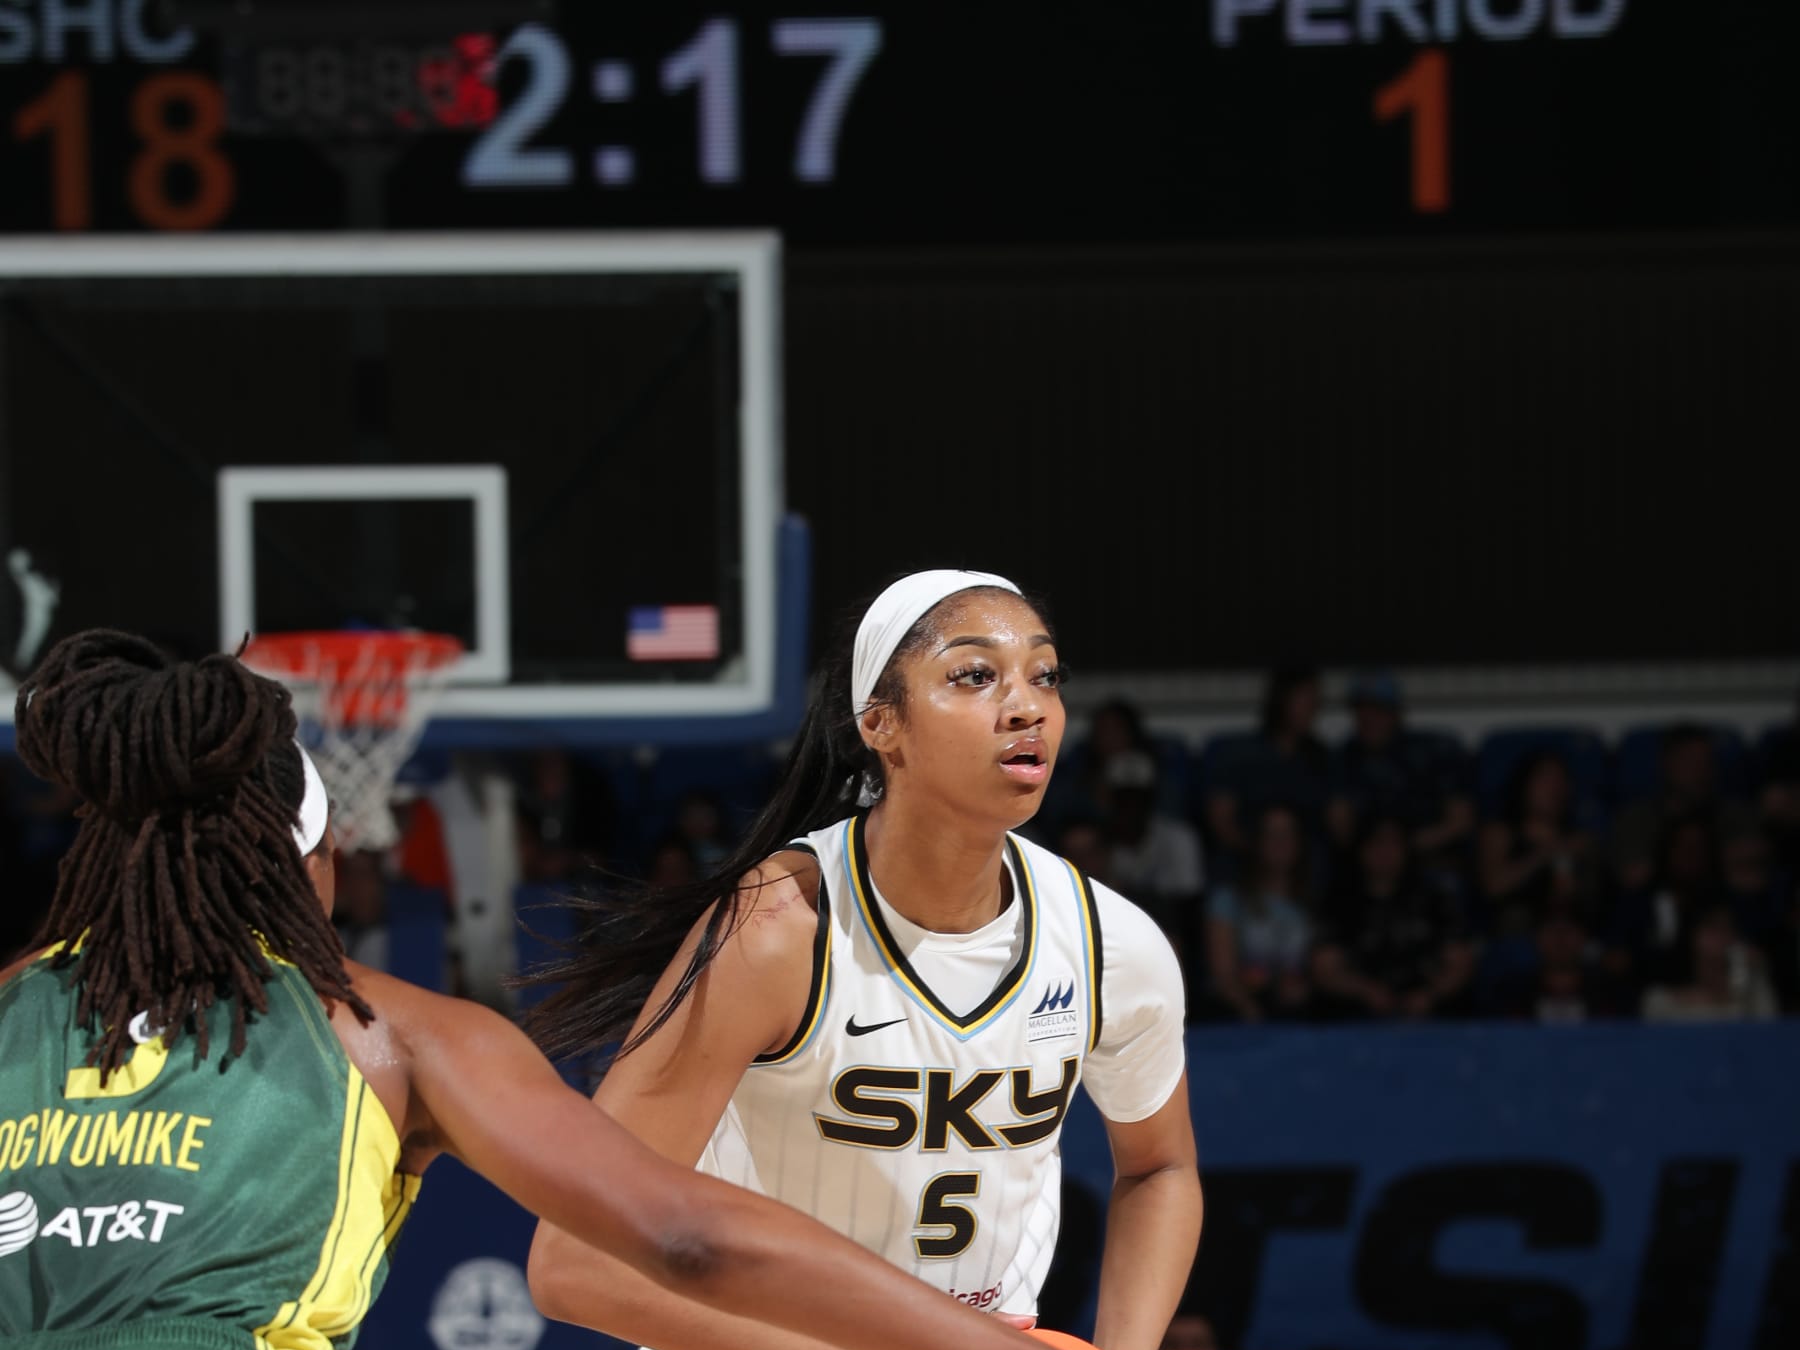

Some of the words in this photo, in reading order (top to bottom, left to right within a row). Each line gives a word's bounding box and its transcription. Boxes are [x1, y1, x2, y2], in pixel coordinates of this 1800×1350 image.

[1212, 0, 1628, 47] PERIOD
[462, 18, 881, 186] 2:17
[1372, 49, 1450, 213] 1
[14, 69, 236, 232] 18
[1028, 1013, 1077, 1030] MAGELLAN
[0, 1107, 212, 1173] OGWUMIKE
[813, 1055, 1080, 1153] SKY
[40, 1200, 184, 1247] AT&T
[911, 1170, 981, 1259] 5
